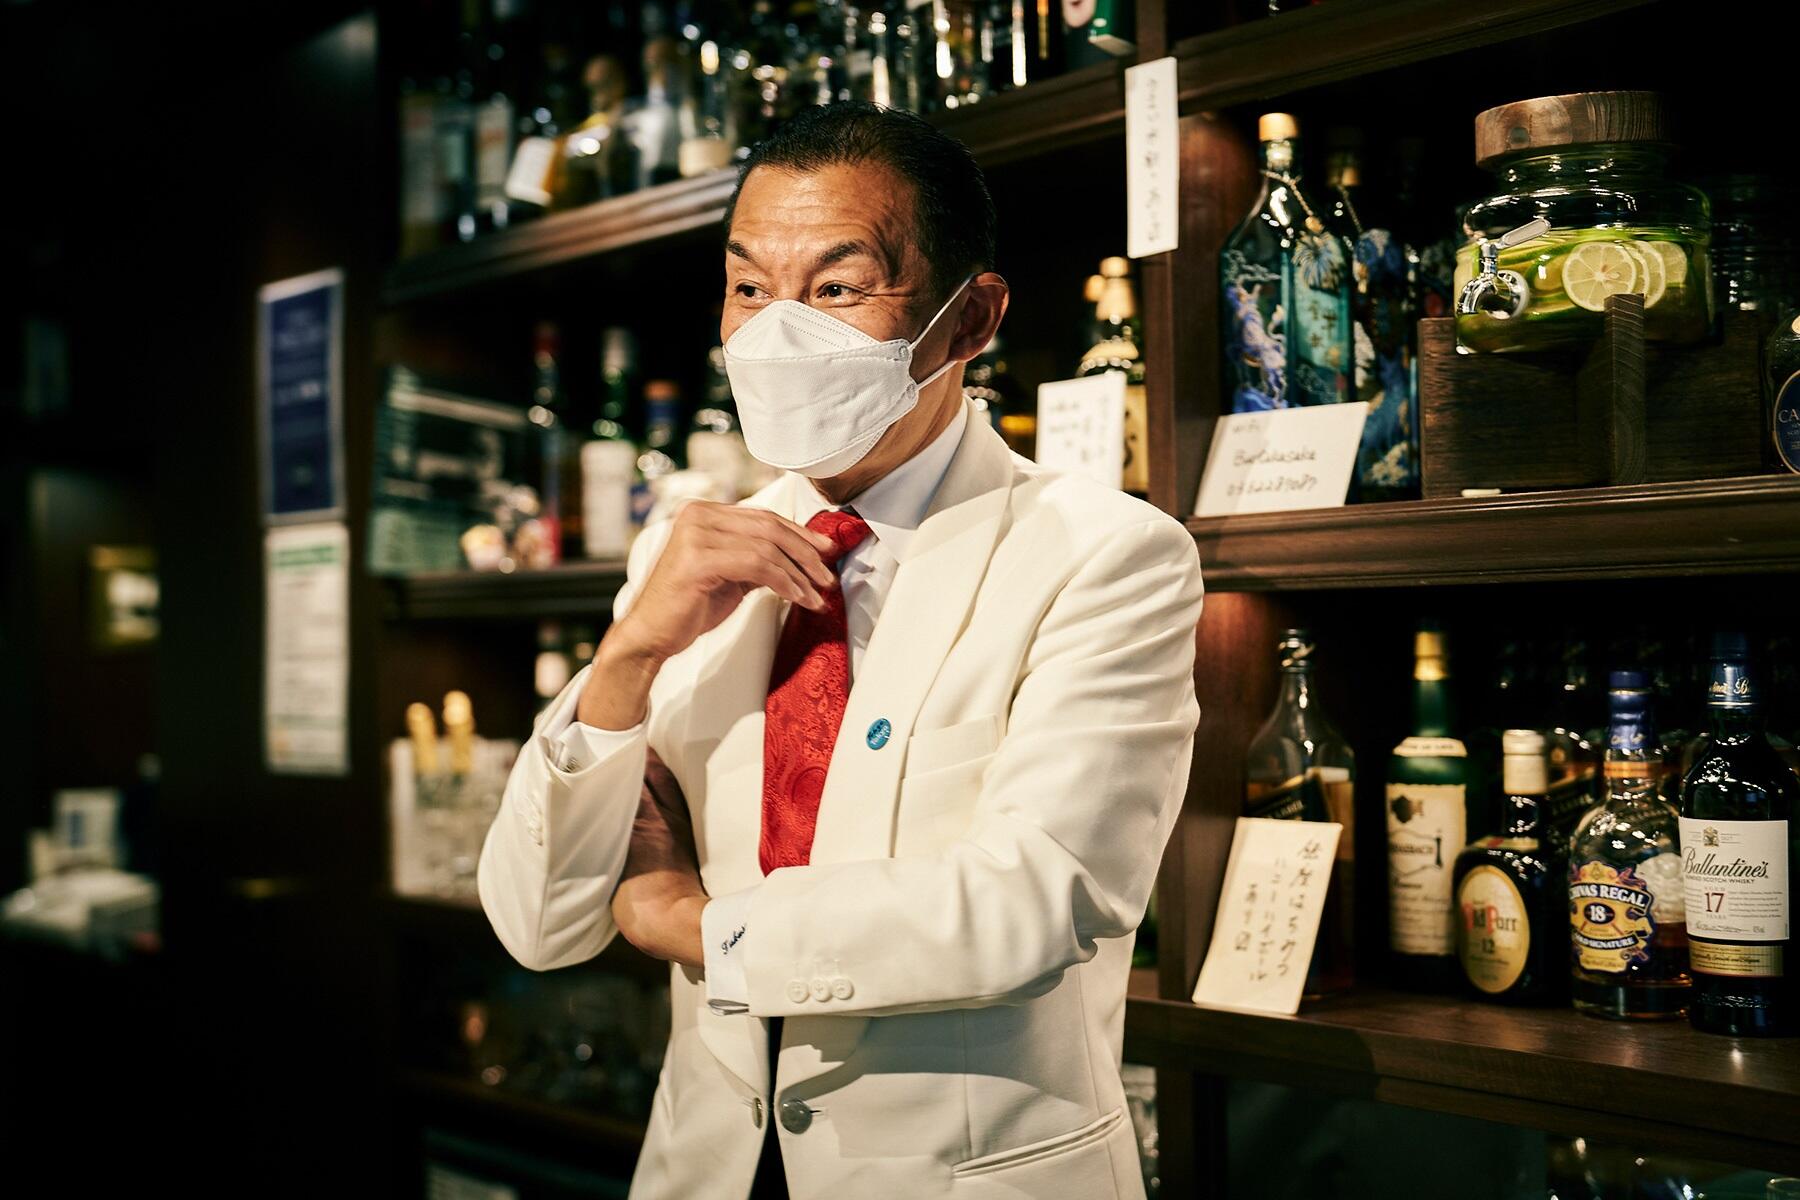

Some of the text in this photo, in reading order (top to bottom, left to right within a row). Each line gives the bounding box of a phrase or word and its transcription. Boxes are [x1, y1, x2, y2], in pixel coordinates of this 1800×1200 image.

[1683, 846, 1768, 877] Ballantine's
[1600, 885, 1645, 907] REGAL
[1704, 892, 1725, 913] 17
[1590, 905, 1606, 921] 18
[1482, 938, 1496, 953] 12
